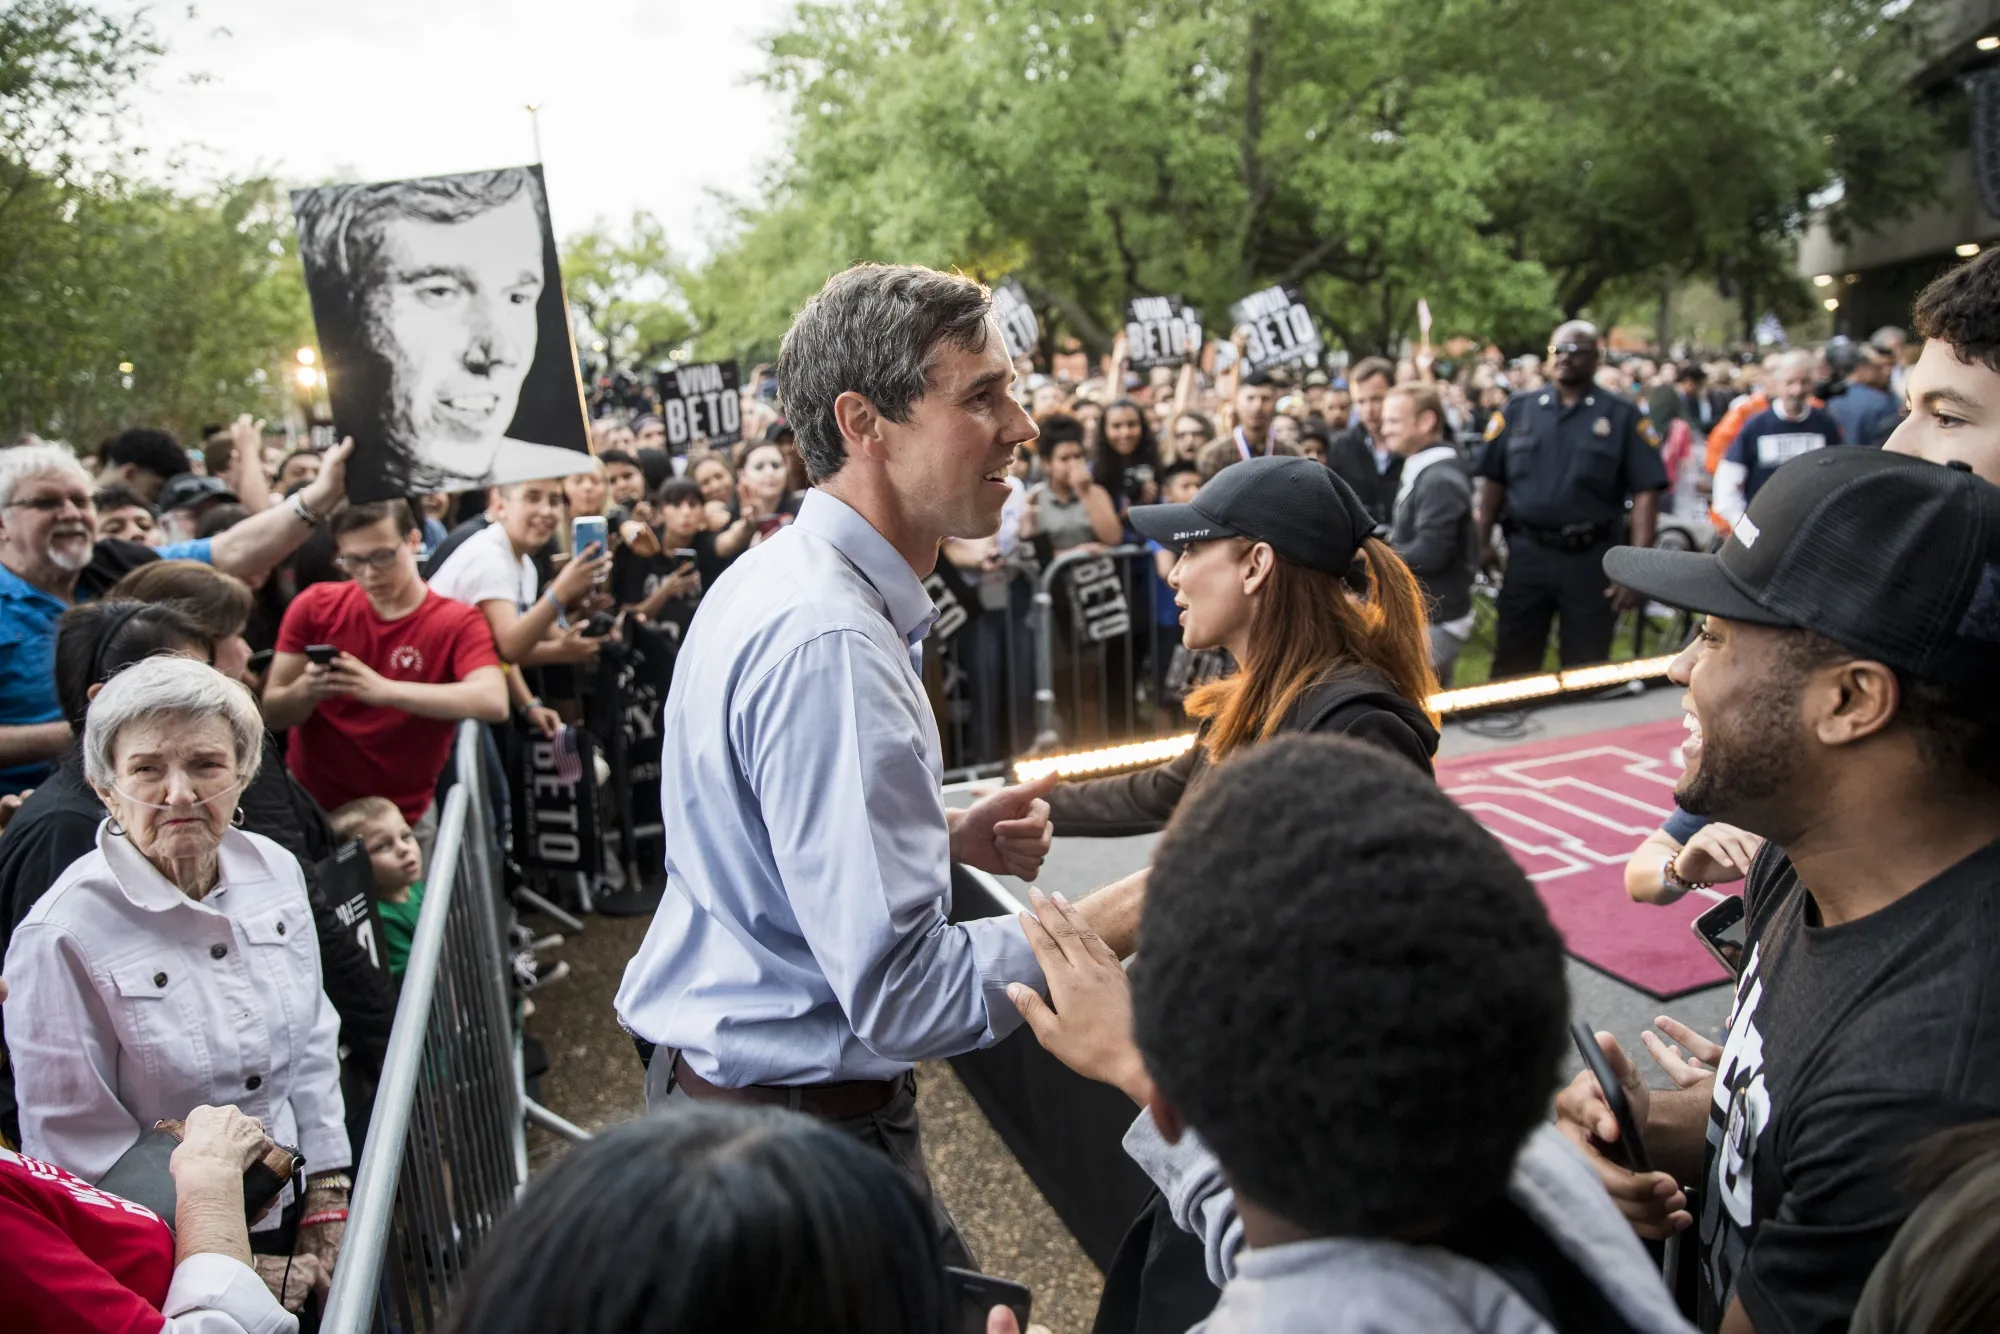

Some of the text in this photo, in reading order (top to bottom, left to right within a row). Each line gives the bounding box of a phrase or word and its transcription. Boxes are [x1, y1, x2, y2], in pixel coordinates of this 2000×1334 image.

[1126, 318, 1186, 361] BETO
[676, 364, 724, 396] VIVA
[665, 390, 739, 444] BETO
[1173, 529, 1210, 540] DRI-FIT
[1073, 556, 1130, 641] BETO
